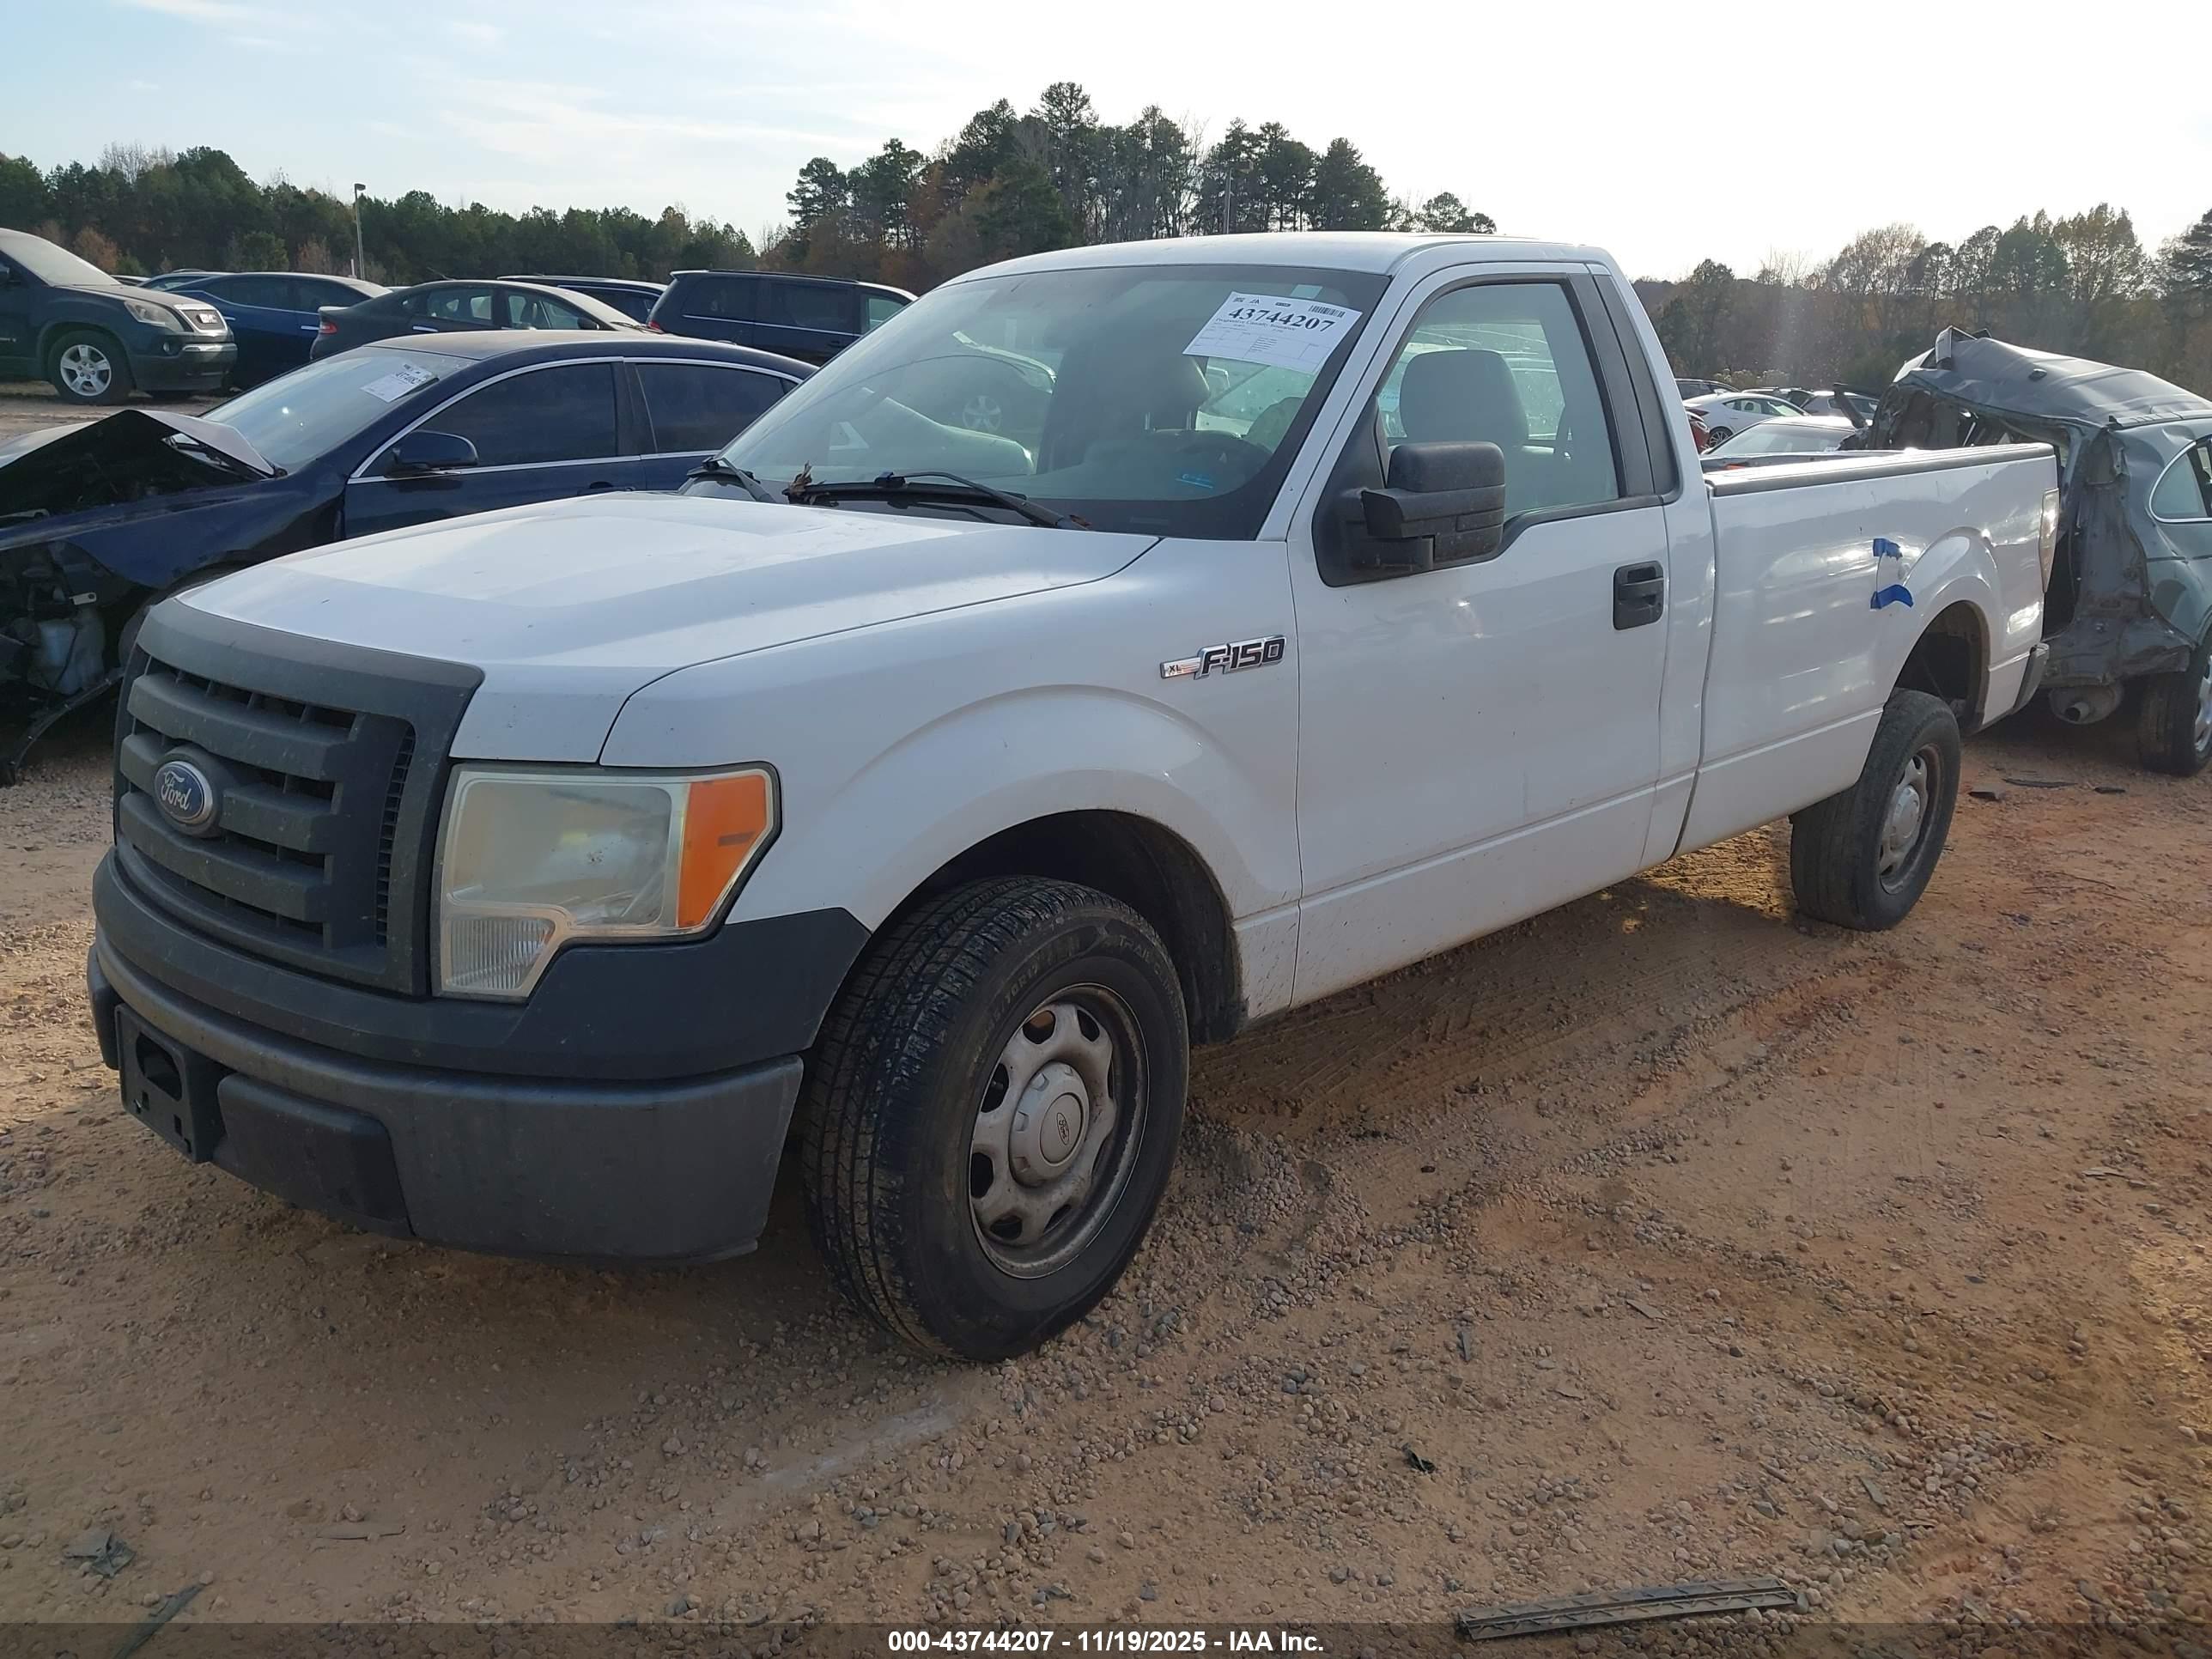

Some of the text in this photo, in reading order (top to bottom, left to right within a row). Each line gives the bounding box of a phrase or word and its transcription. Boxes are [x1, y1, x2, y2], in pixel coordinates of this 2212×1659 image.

[1229, 307, 1335, 332] 43744207
[1169, 635, 1286, 677] XL F-150
[161, 770, 191, 811] Ford
